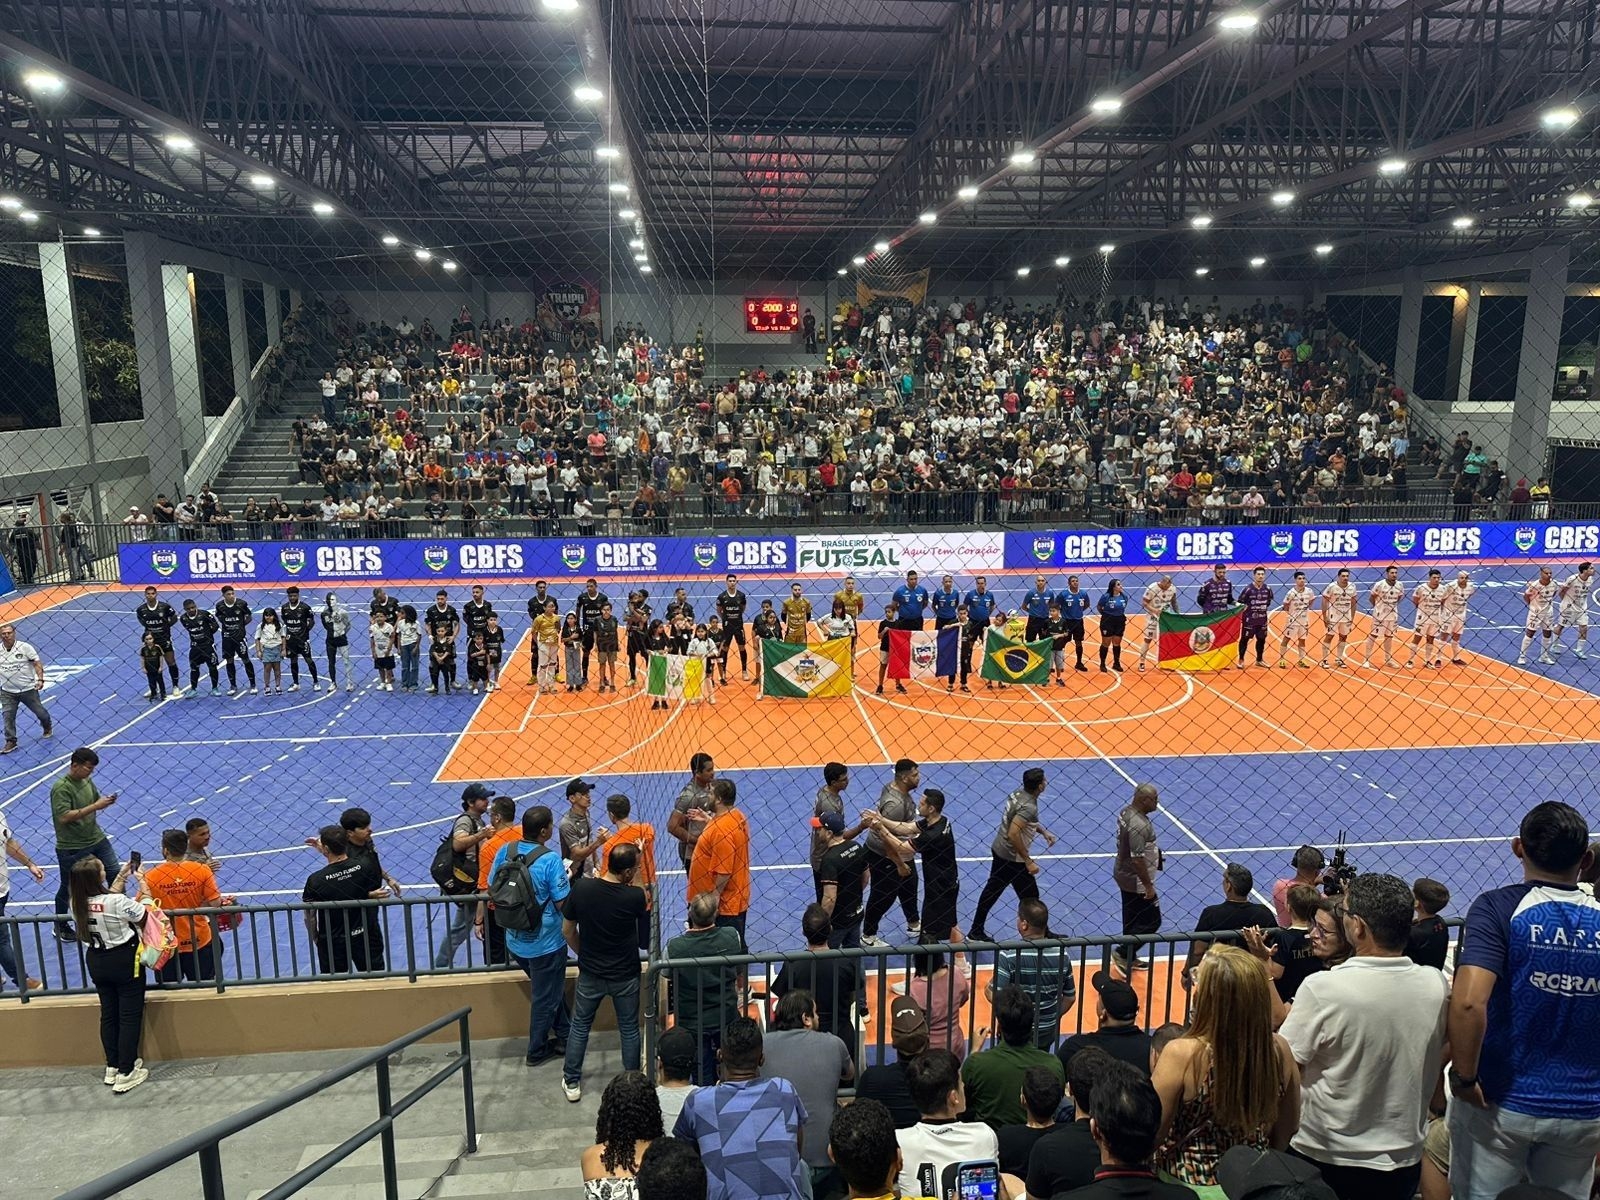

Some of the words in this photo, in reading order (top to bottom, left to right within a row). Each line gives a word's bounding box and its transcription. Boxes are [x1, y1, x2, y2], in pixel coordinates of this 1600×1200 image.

[549, 293, 584, 304] TRAIPU
[821, 539, 867, 548] BRASILEIRO
[868, 539, 879, 547] DE
[1065, 534, 1122, 558] CBFS
[1177, 532, 1233, 556] CBFS
[1302, 529, 1359, 553] CBFS
[1425, 527, 1480, 551] CBFS
[1545, 526, 1599, 549] CBFS
[189, 548, 255, 573] CBFS
[317, 546, 382, 571] CBFS
[460, 544, 523, 568] CBFS
[596, 542, 657, 567] CBFS
[728, 541, 787, 565] CBFS
[800, 547, 900, 568] FUTSAL
[902, 547, 929, 558] Aqui
[930, 546, 953, 556] Tem
[957, 546, 1000, 558] Coração
[325, 871, 343, 880] PASSO
[1533, 971, 1600, 993] ROBRA
